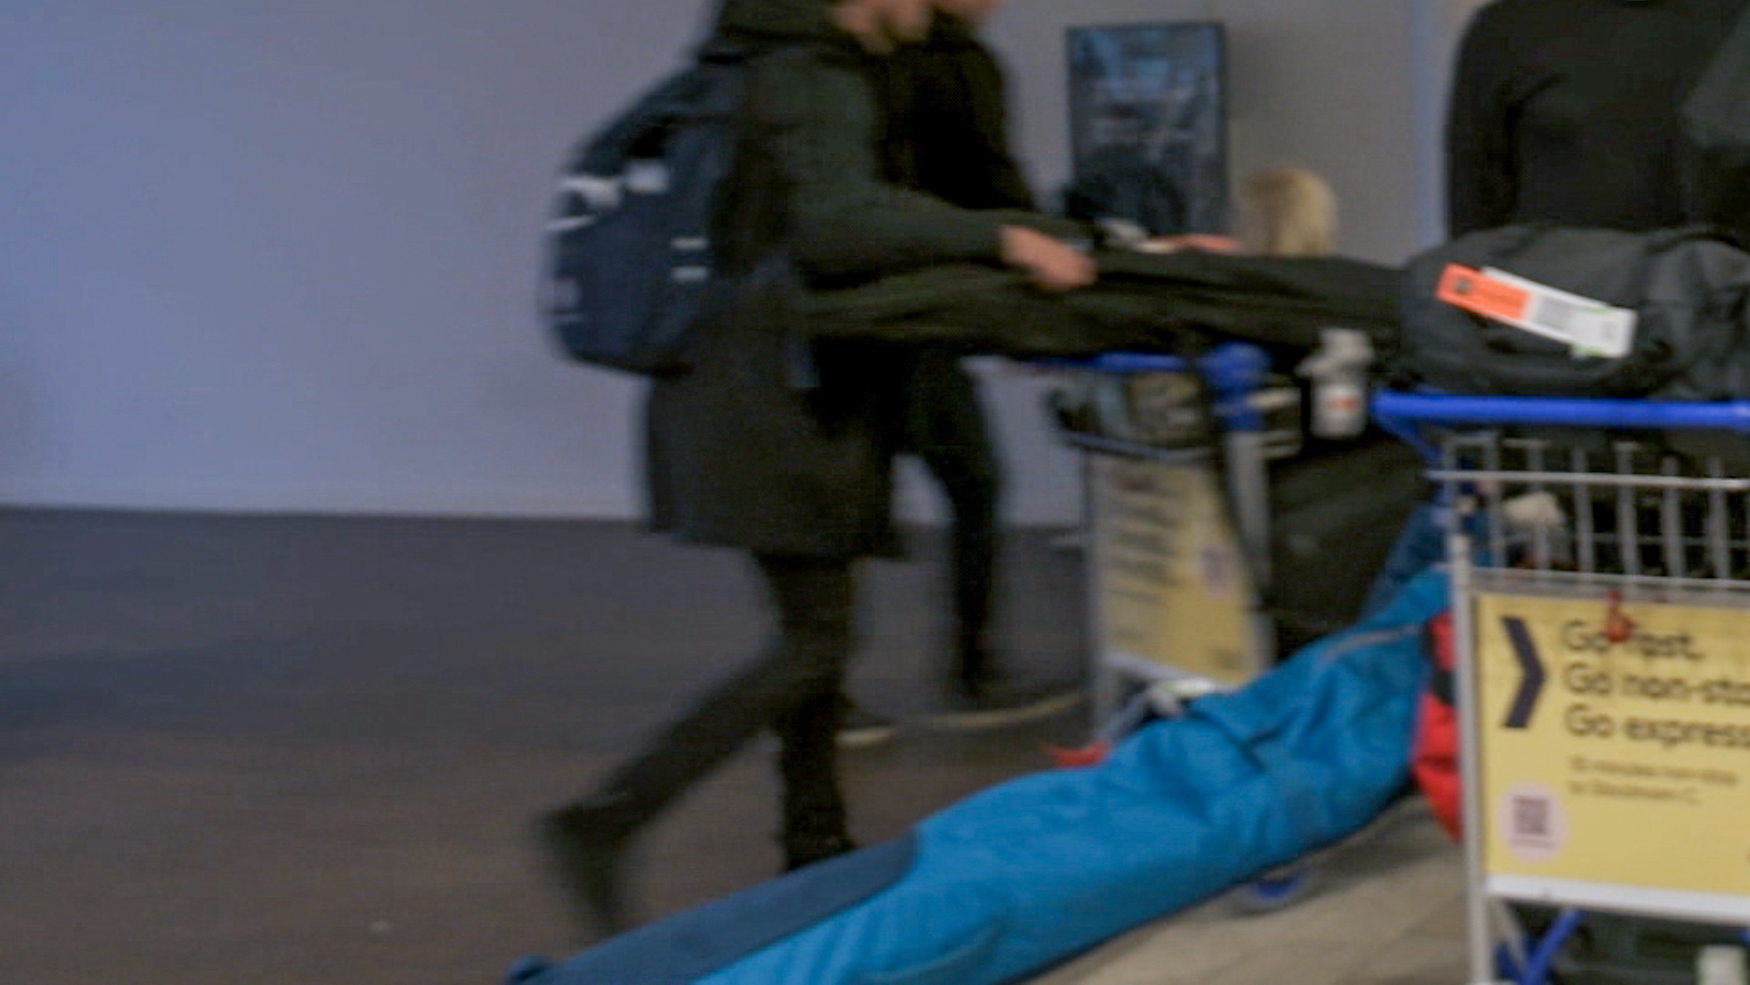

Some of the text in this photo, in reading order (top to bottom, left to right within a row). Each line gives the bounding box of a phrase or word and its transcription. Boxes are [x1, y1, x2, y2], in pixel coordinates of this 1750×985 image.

[1562, 619, 1611, 654] Go
[1564, 662, 1613, 696] Go
[1565, 703, 1615, 738] Go
